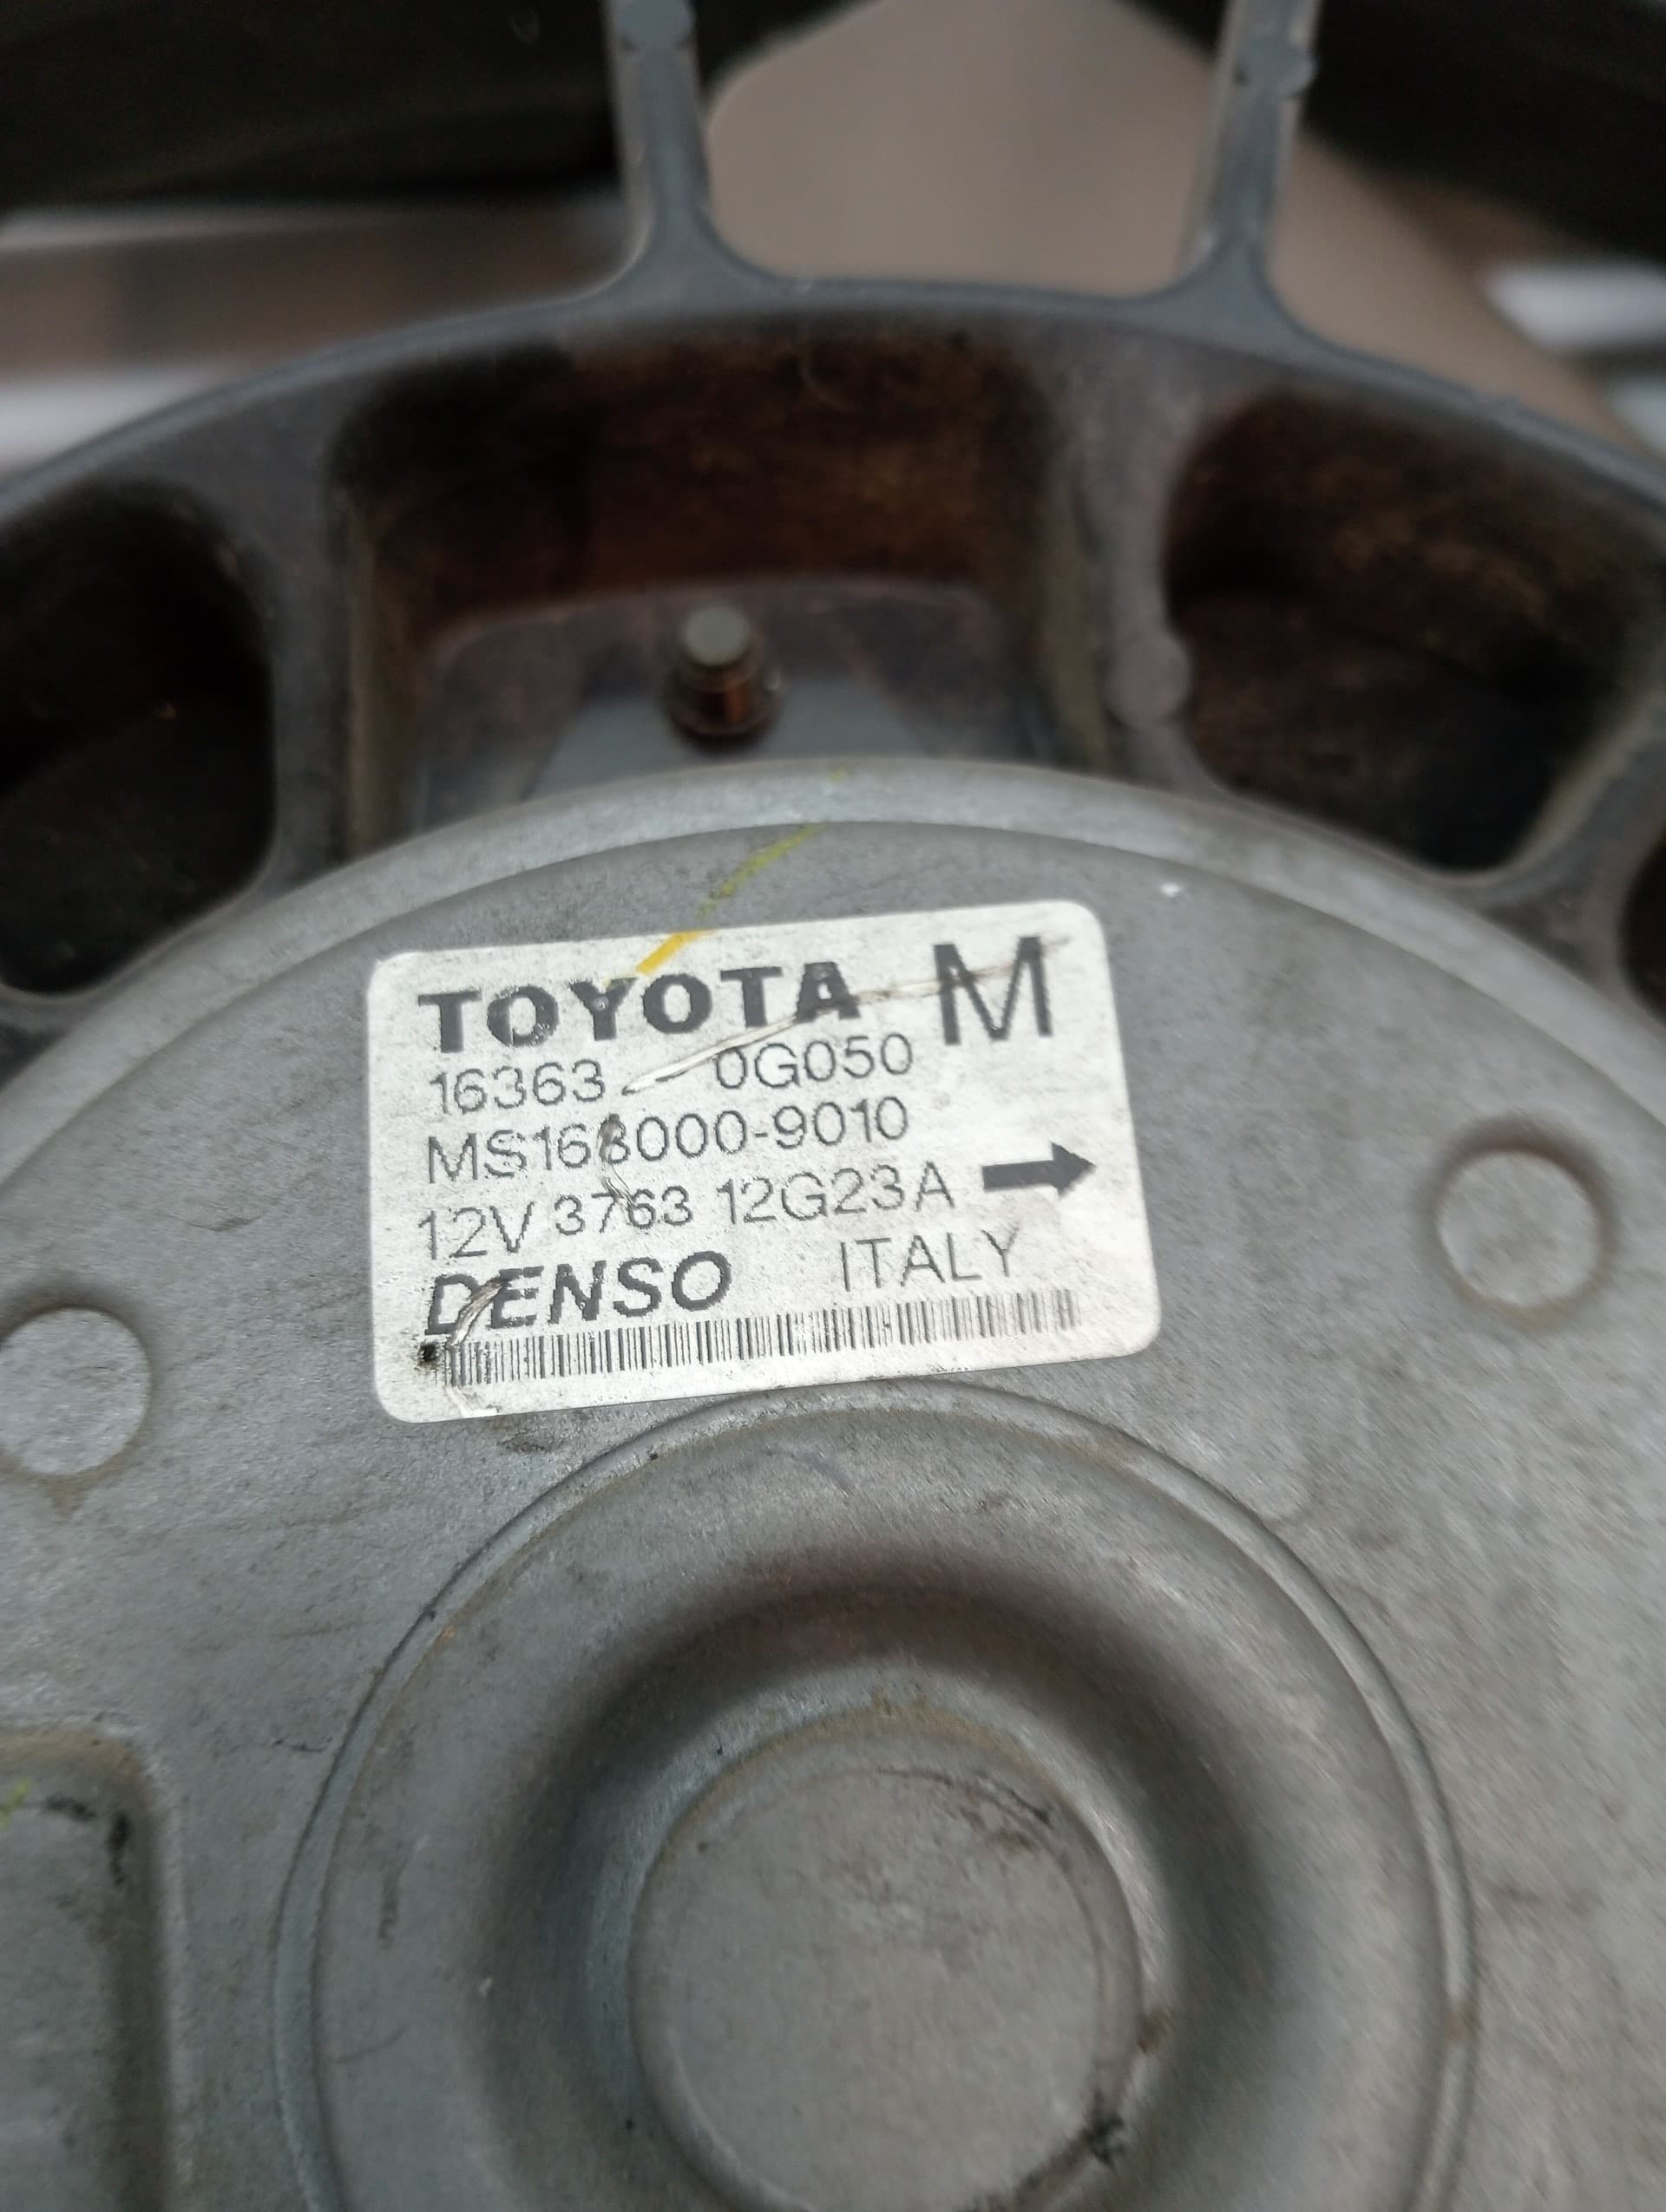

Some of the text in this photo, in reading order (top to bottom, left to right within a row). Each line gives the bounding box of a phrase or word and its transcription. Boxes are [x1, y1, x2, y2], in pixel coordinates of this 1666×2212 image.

[417, 935, 1053, 1053] TOYOTA M
[430, 1032, 914, 1115] 16363 0G050
[427, 1096, 908, 1184] MS168000-9010
[418, 1161, 955, 1260] 12V 3763 12G23A
[424, 1227, 1020, 1336] DENSO ITALY
